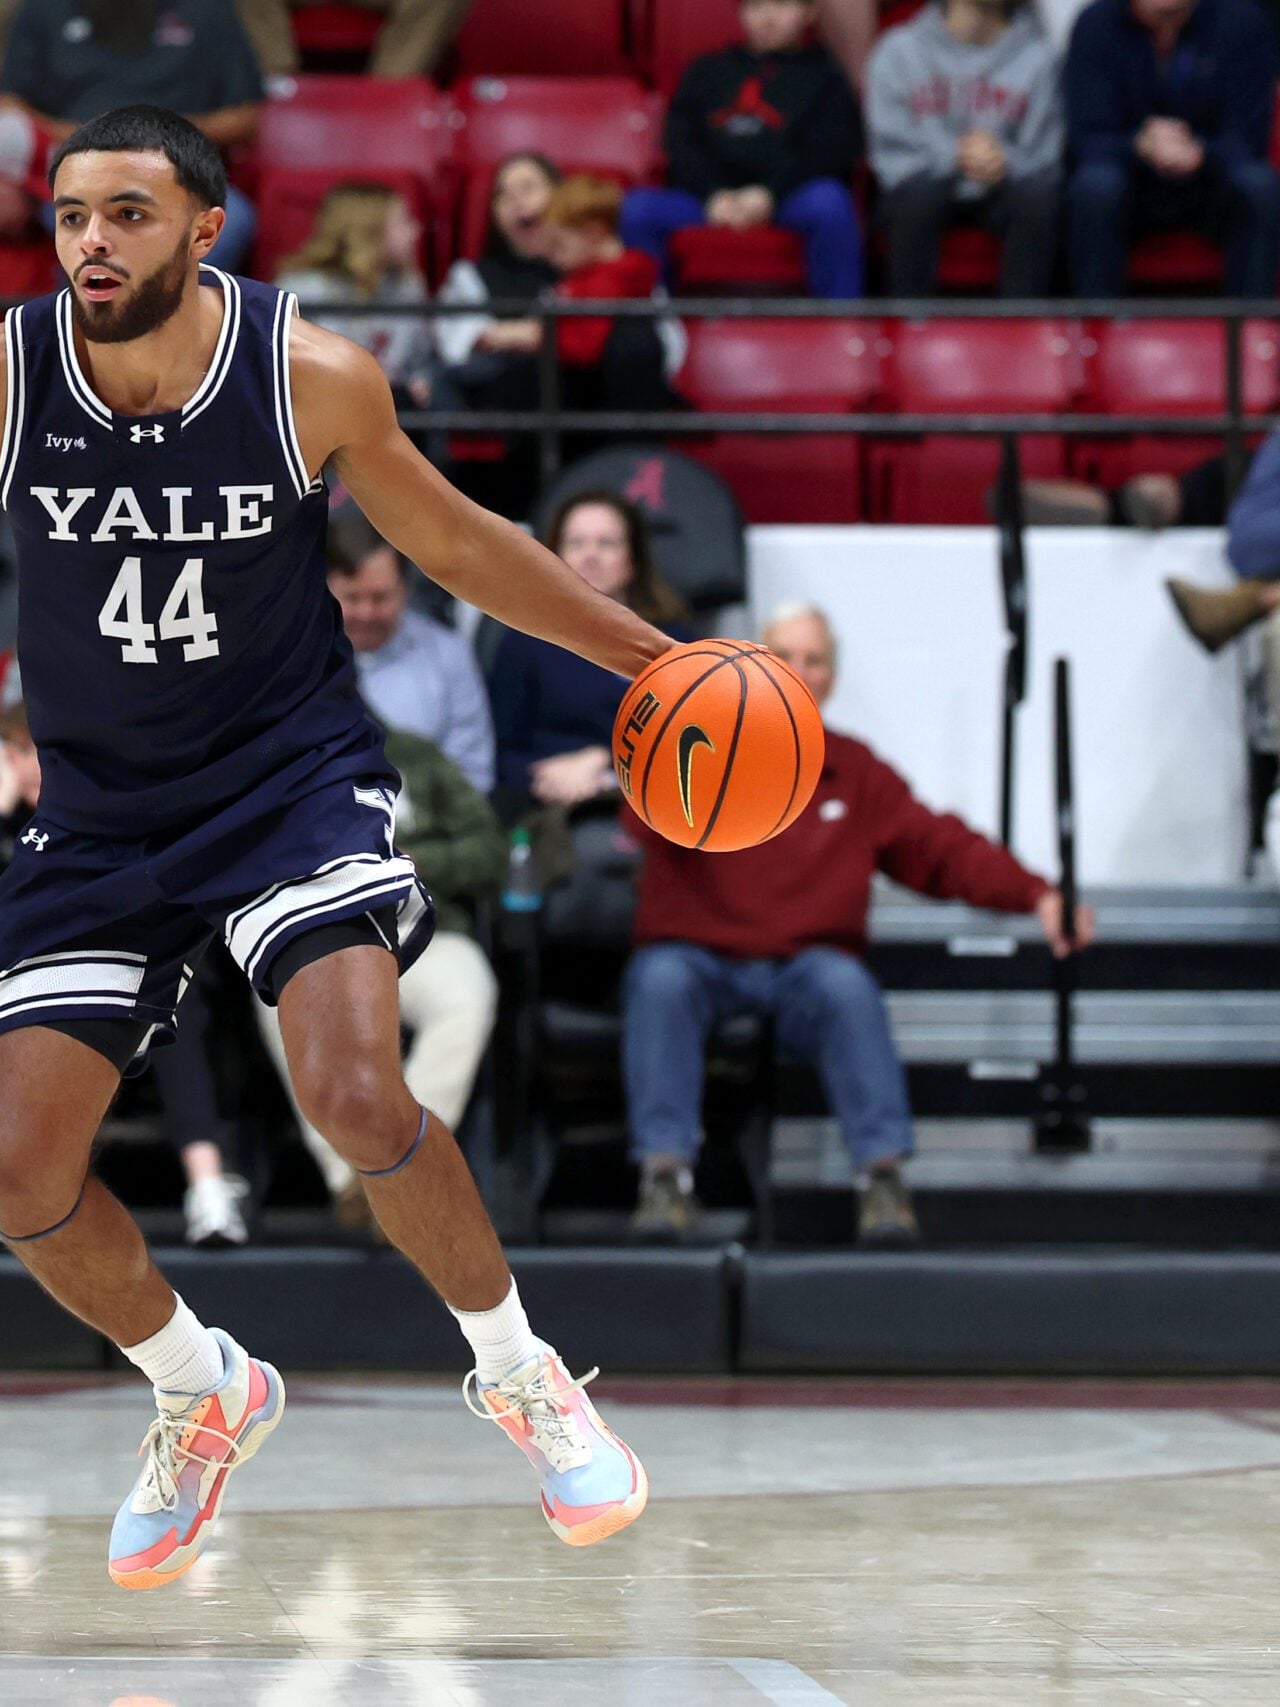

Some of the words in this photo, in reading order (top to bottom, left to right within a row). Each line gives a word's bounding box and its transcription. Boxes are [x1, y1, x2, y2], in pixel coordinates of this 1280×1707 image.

[45, 433, 73, 452] Ivy
[30, 484, 274, 542] YALE
[98, 556, 220, 664] 44
[618, 689, 662, 799] ELITE
